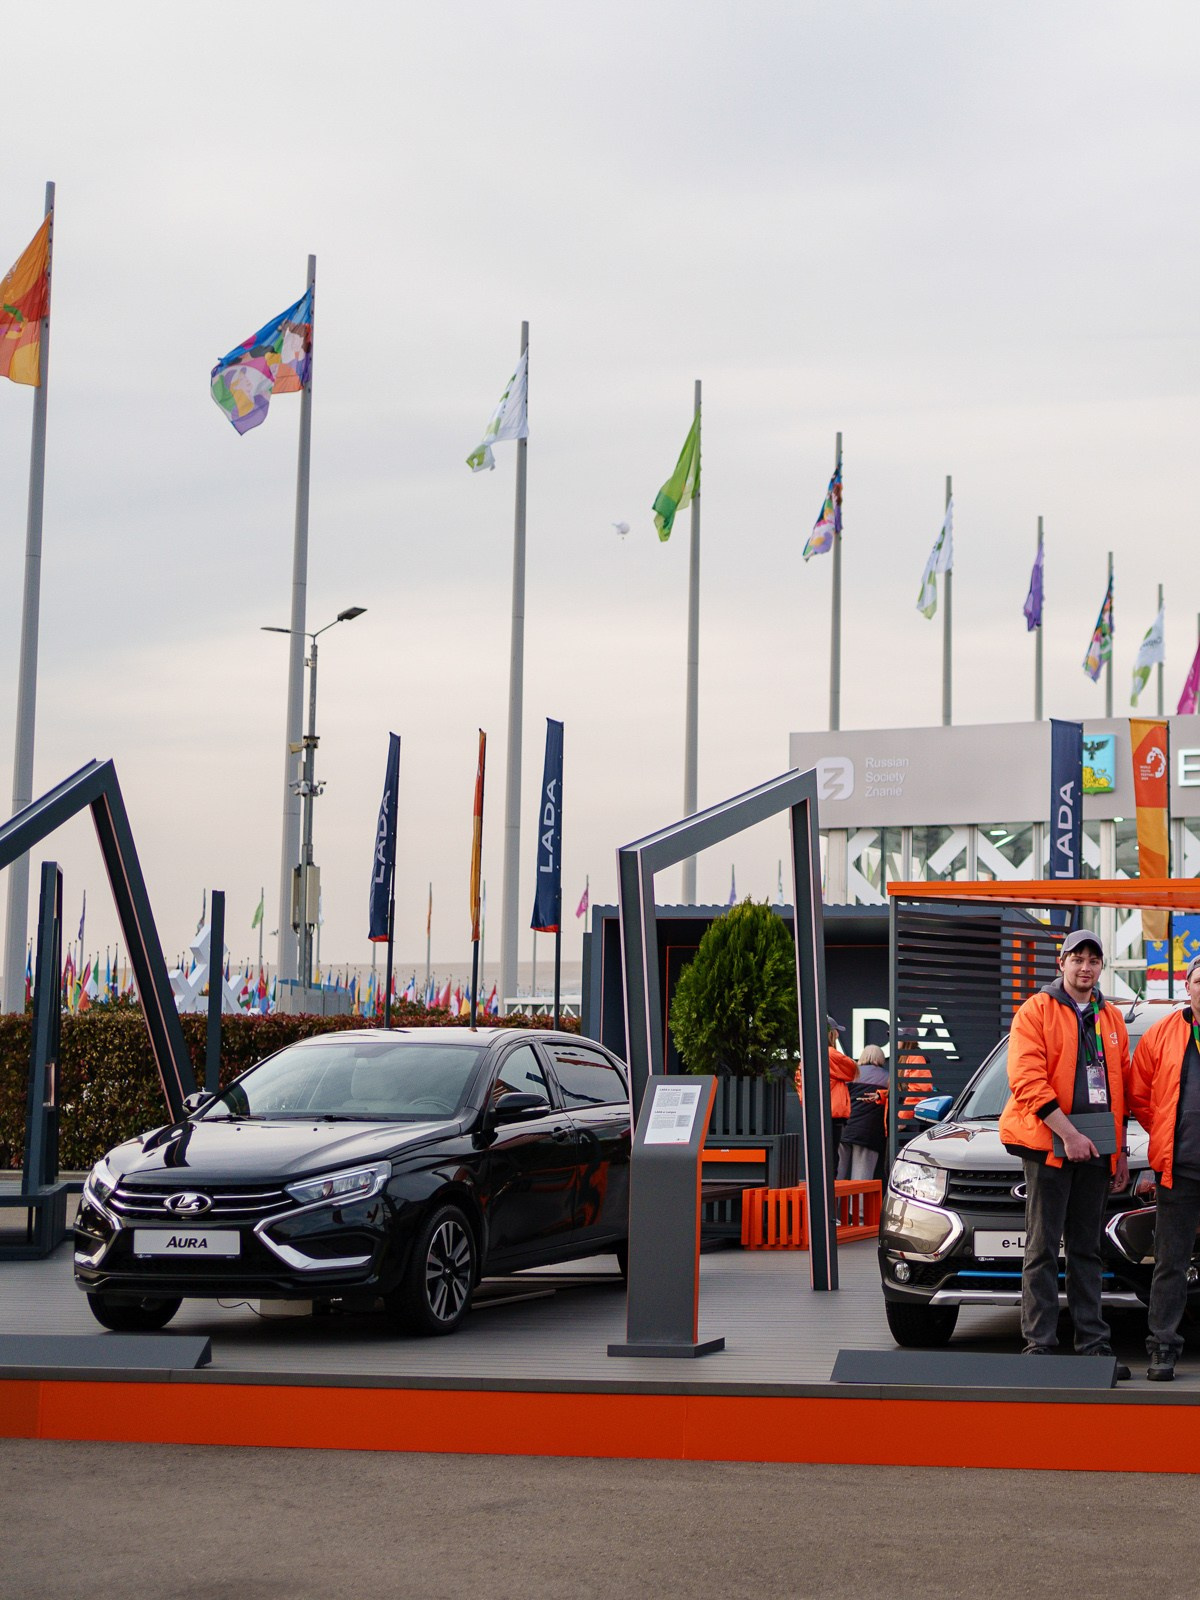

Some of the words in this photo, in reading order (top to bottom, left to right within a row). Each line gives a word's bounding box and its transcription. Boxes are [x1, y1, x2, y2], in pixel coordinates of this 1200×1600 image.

[865, 757, 909, 768] Russian
[865, 771, 905, 785] Society
[865, 785, 903, 797] Znanie
[540, 778, 557, 873] LADA
[1055, 780, 1075, 878] LADA
[375, 790, 391, 883] LADA
[166, 1236, 208, 1249] AURA
